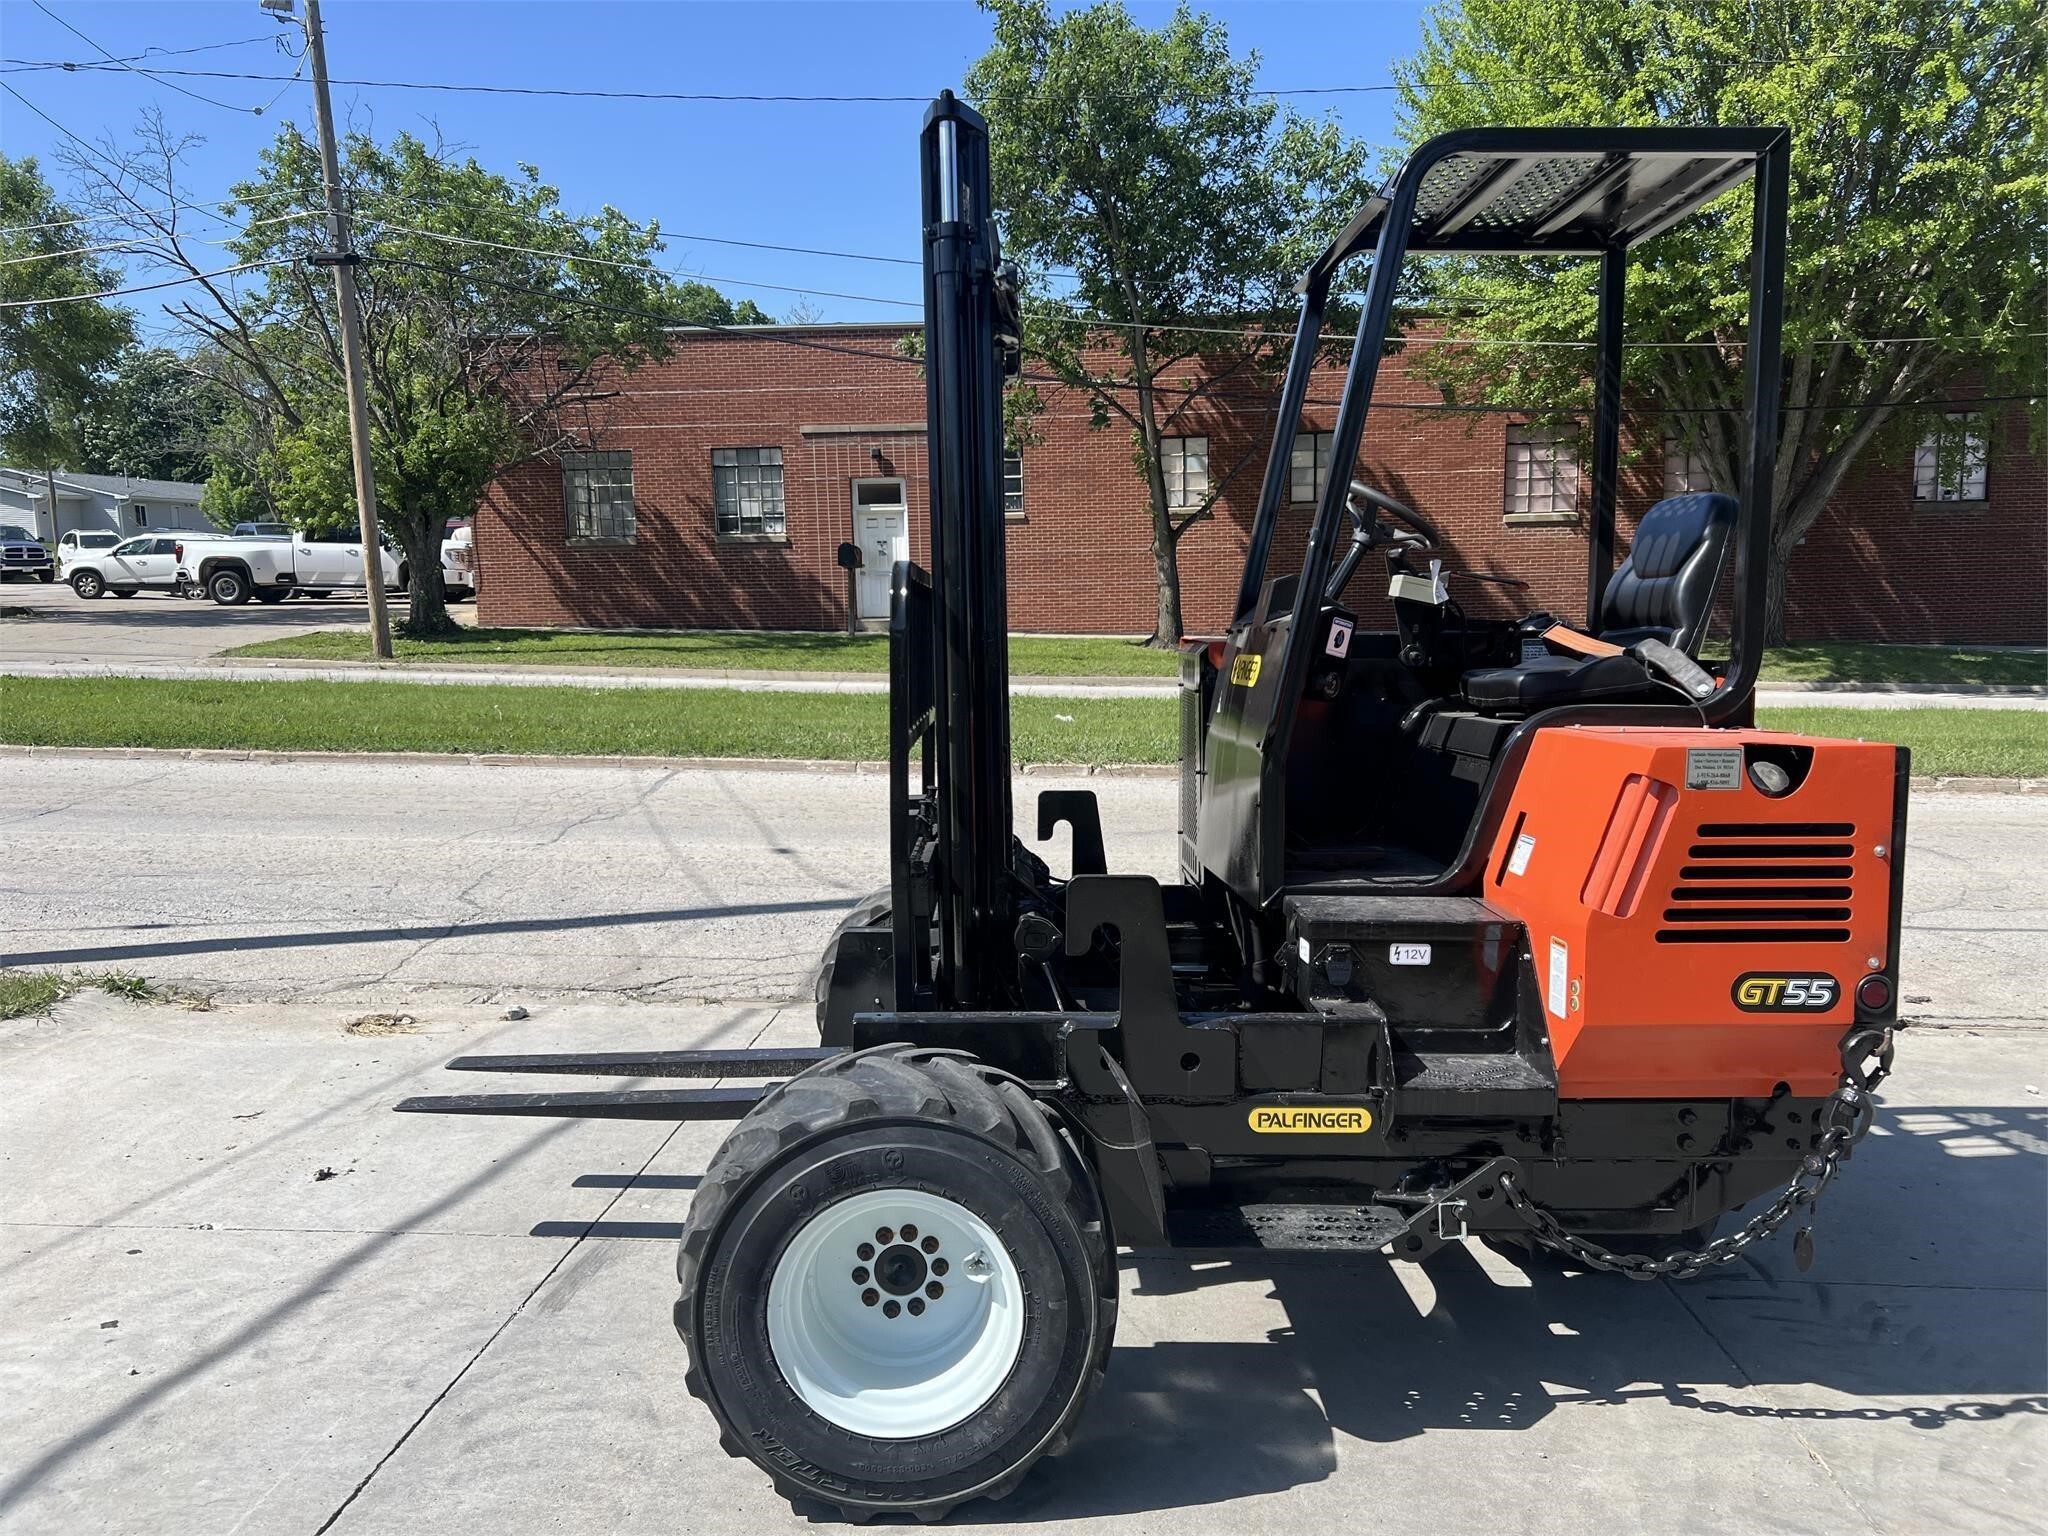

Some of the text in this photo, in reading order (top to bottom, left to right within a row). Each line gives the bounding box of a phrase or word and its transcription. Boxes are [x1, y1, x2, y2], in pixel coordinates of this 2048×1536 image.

[1404, 949, 1428, 960] 12V
[1737, 978, 1835, 1006] GT55
[1258, 1112, 1362, 1128] PALFINGER
